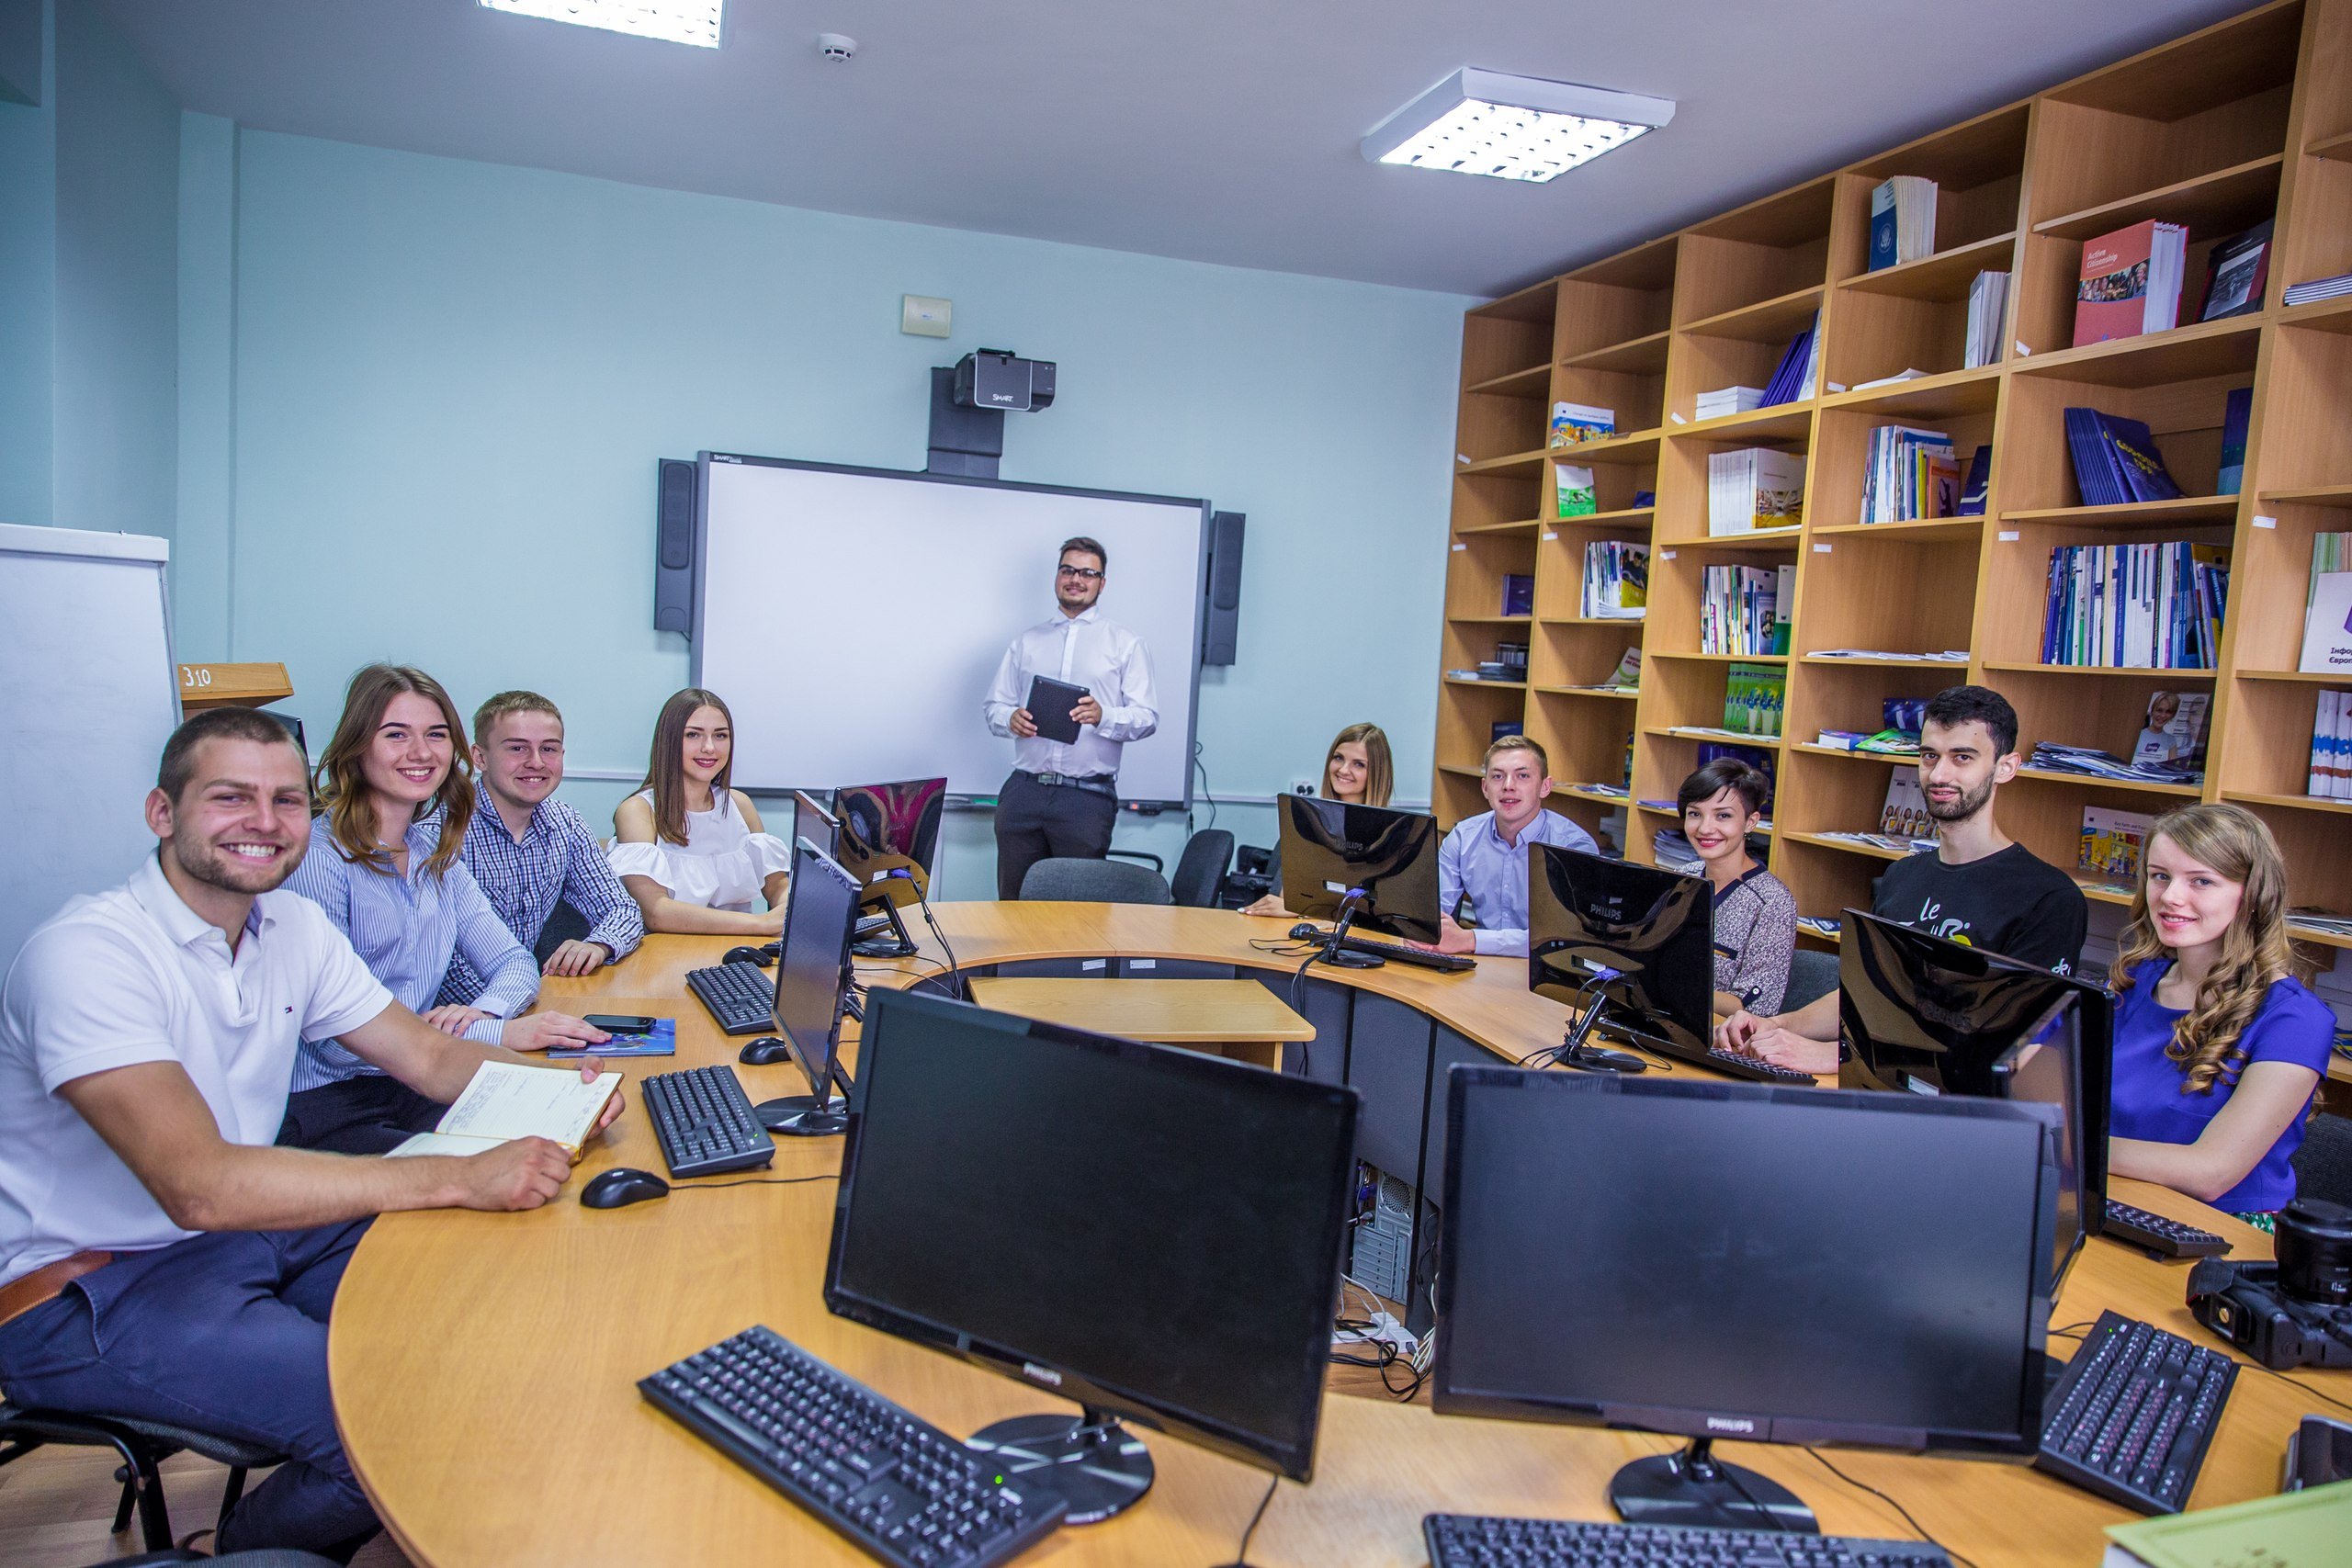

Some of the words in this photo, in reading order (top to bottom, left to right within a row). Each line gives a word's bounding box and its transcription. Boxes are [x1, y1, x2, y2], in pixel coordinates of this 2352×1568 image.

[2086, 253, 2119, 269] Citizenship
[2087, 249, 2106, 260] Active
[992, 393, 1014, 402] SMART
[183, 666, 212, 687] 310
[1590, 903, 1622, 920] PHILIPS
[1920, 897, 1941, 921] Le
[1023, 1361, 1062, 1386] PHILIPS
[1707, 1416, 1754, 1433] PHILIPS
